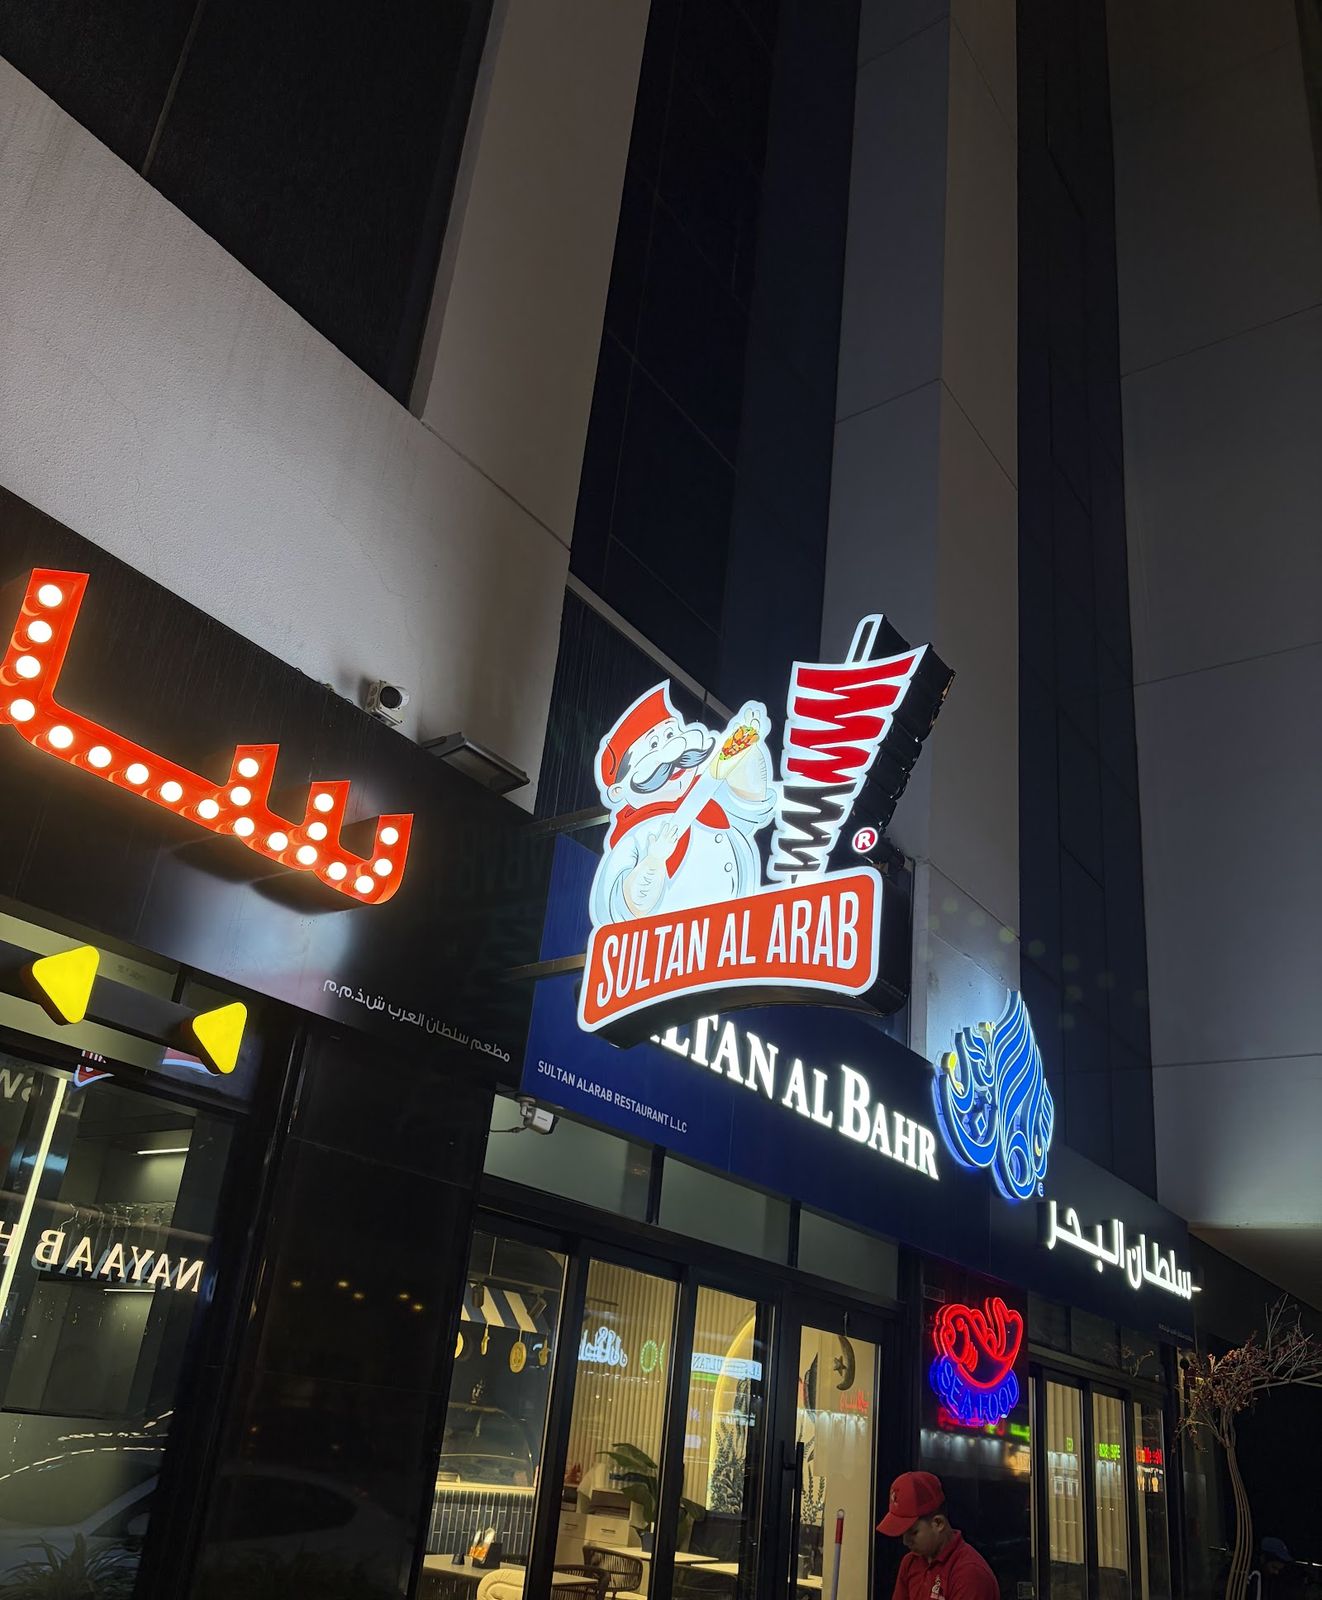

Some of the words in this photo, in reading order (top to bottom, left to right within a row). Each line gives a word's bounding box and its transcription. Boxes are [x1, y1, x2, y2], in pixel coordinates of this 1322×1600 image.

[596, 917, 710, 1007] SULTAN
[717, 909, 756, 968] AL
[766, 891, 859, 970] ARAB
[387, 1003, 425, 1028] العرب
[426, 1016, 469, 1046] سلطان
[470, 1037, 512, 1063] مطعم
[536, 1059, 576, 1087] SULTAN
[576, 1077, 613, 1103] ALARAB
[613, 1092, 669, 1126] RESTAURANT
[650, 1013, 779, 1100] LTAN
[781, 1057, 834, 1128] AL
[838, 1063, 940, 1181] BAHR
[1046, 1199, 1126, 1273] البحر
[1126, 1233, 1193, 1301] سلطان
